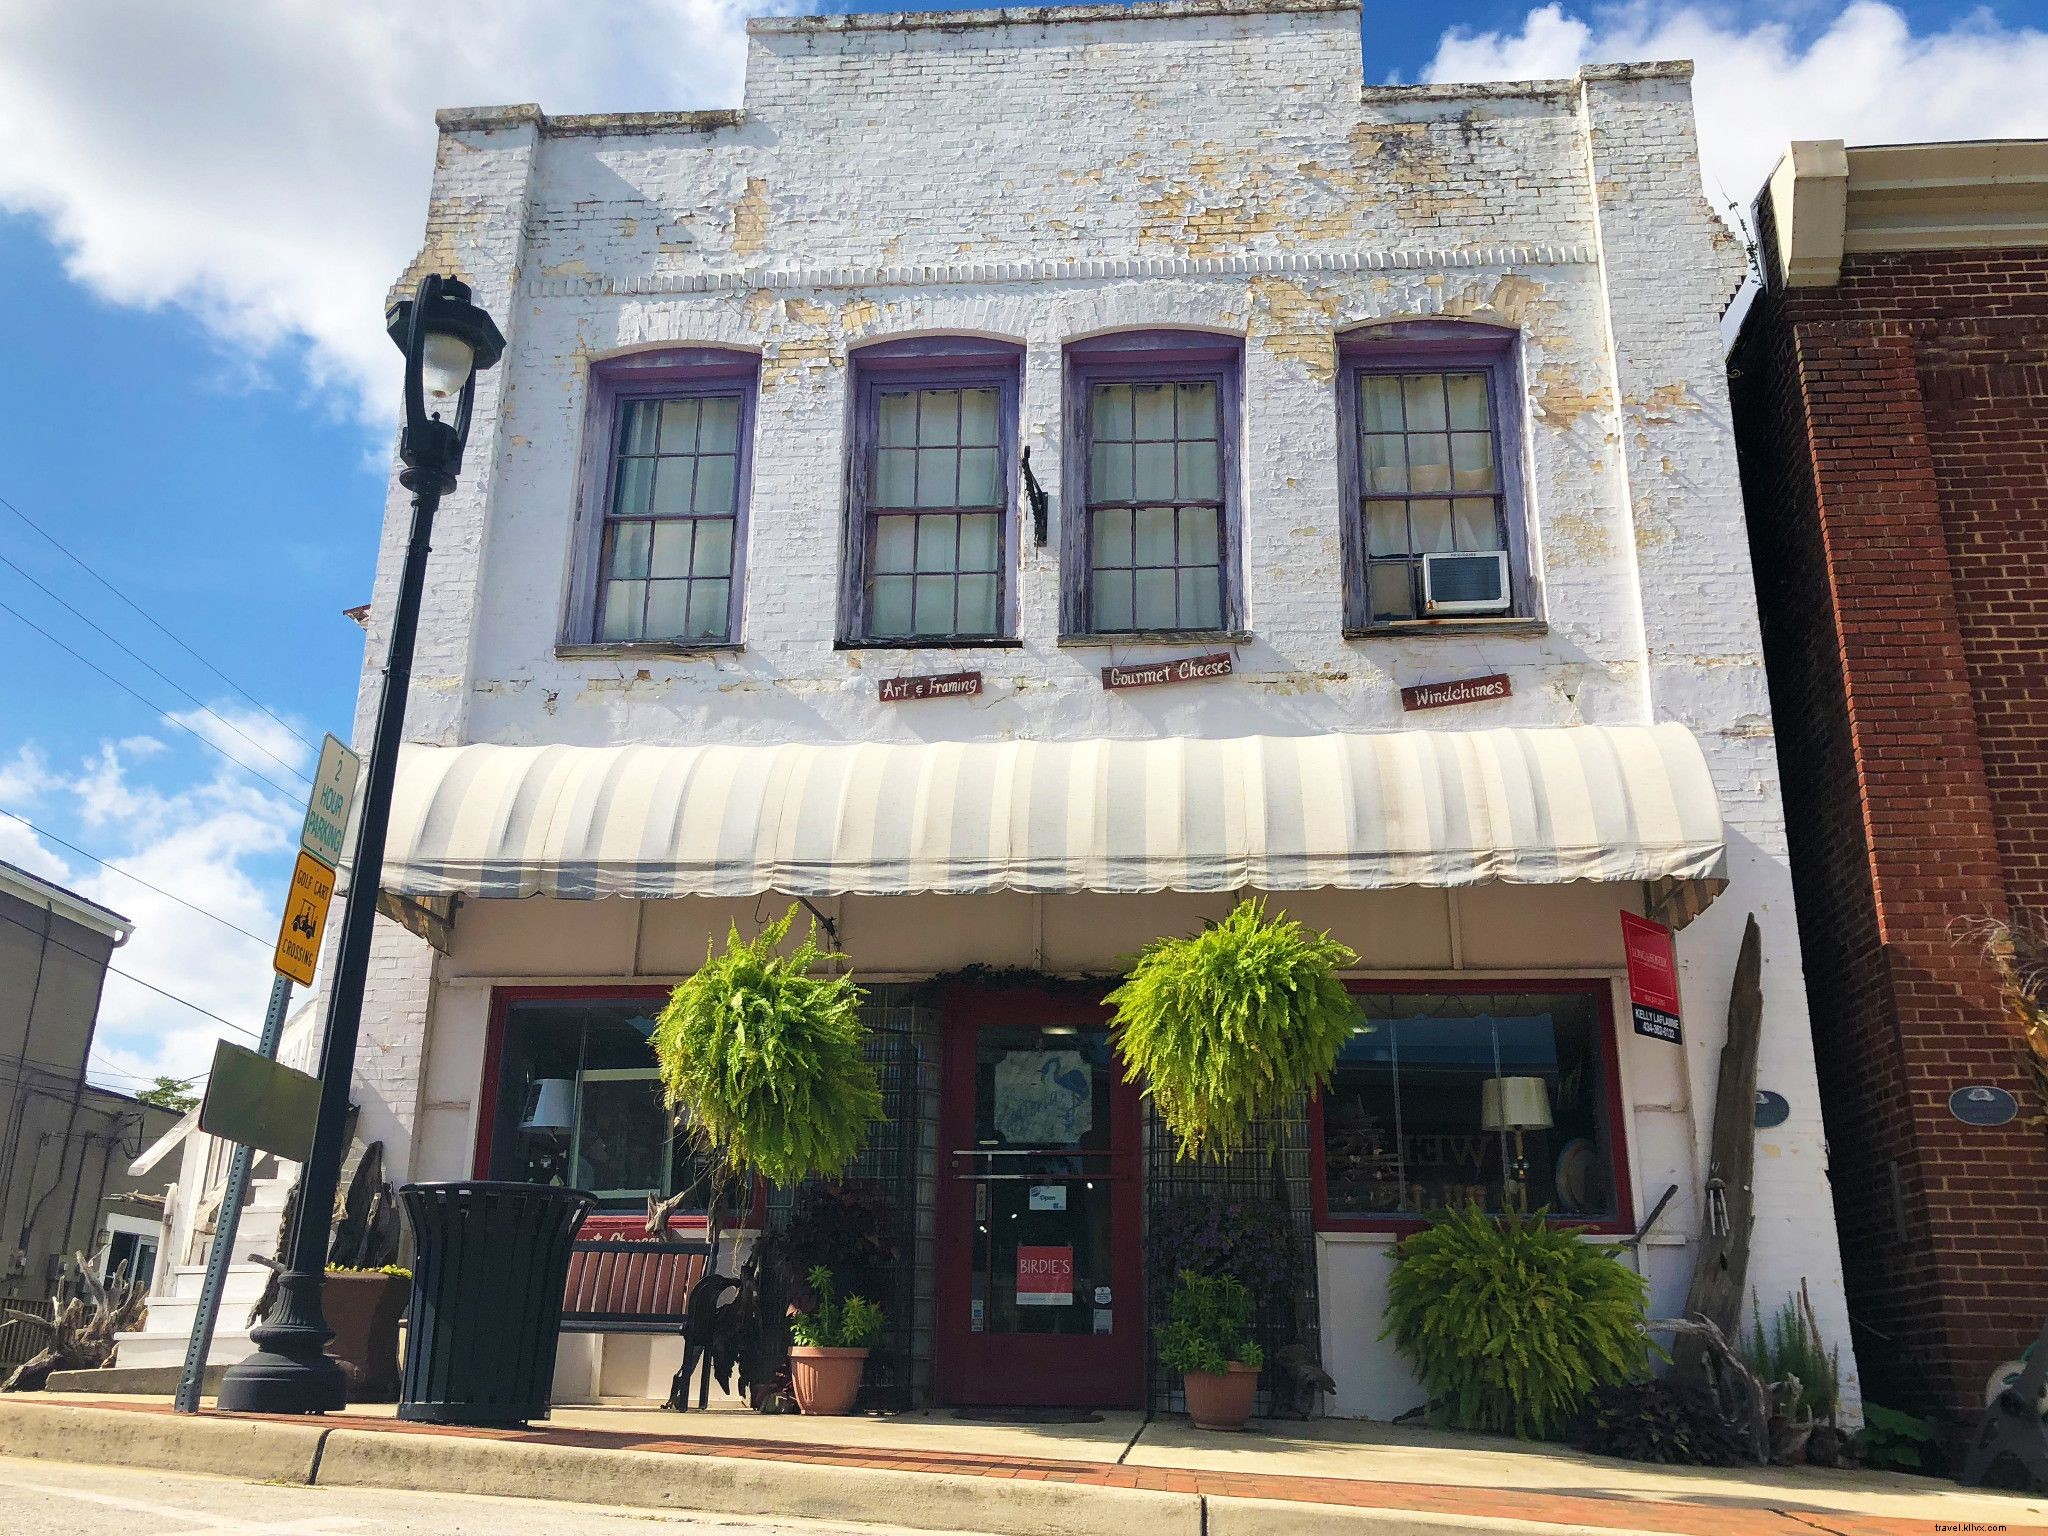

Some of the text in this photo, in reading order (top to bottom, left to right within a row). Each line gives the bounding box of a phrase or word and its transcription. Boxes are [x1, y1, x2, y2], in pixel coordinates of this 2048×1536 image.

[1111, 660, 1231, 686] Gourmet Cheeses
[883, 677, 977, 699] Art & Framing
[1414, 681, 1504, 706] Windchimes
[334, 759, 343, 783] 2
[319, 783, 344, 818] HOUR
[306, 810, 342, 852] PARKING
[296, 869, 329, 901] GOLF CART
[282, 938, 314, 968] CROSSING
[1635, 1008, 1653, 1022] KELLY
[1039, 1194, 1056, 1202] Open
[1020, 1258, 1070, 1274] BIRDIE'S
